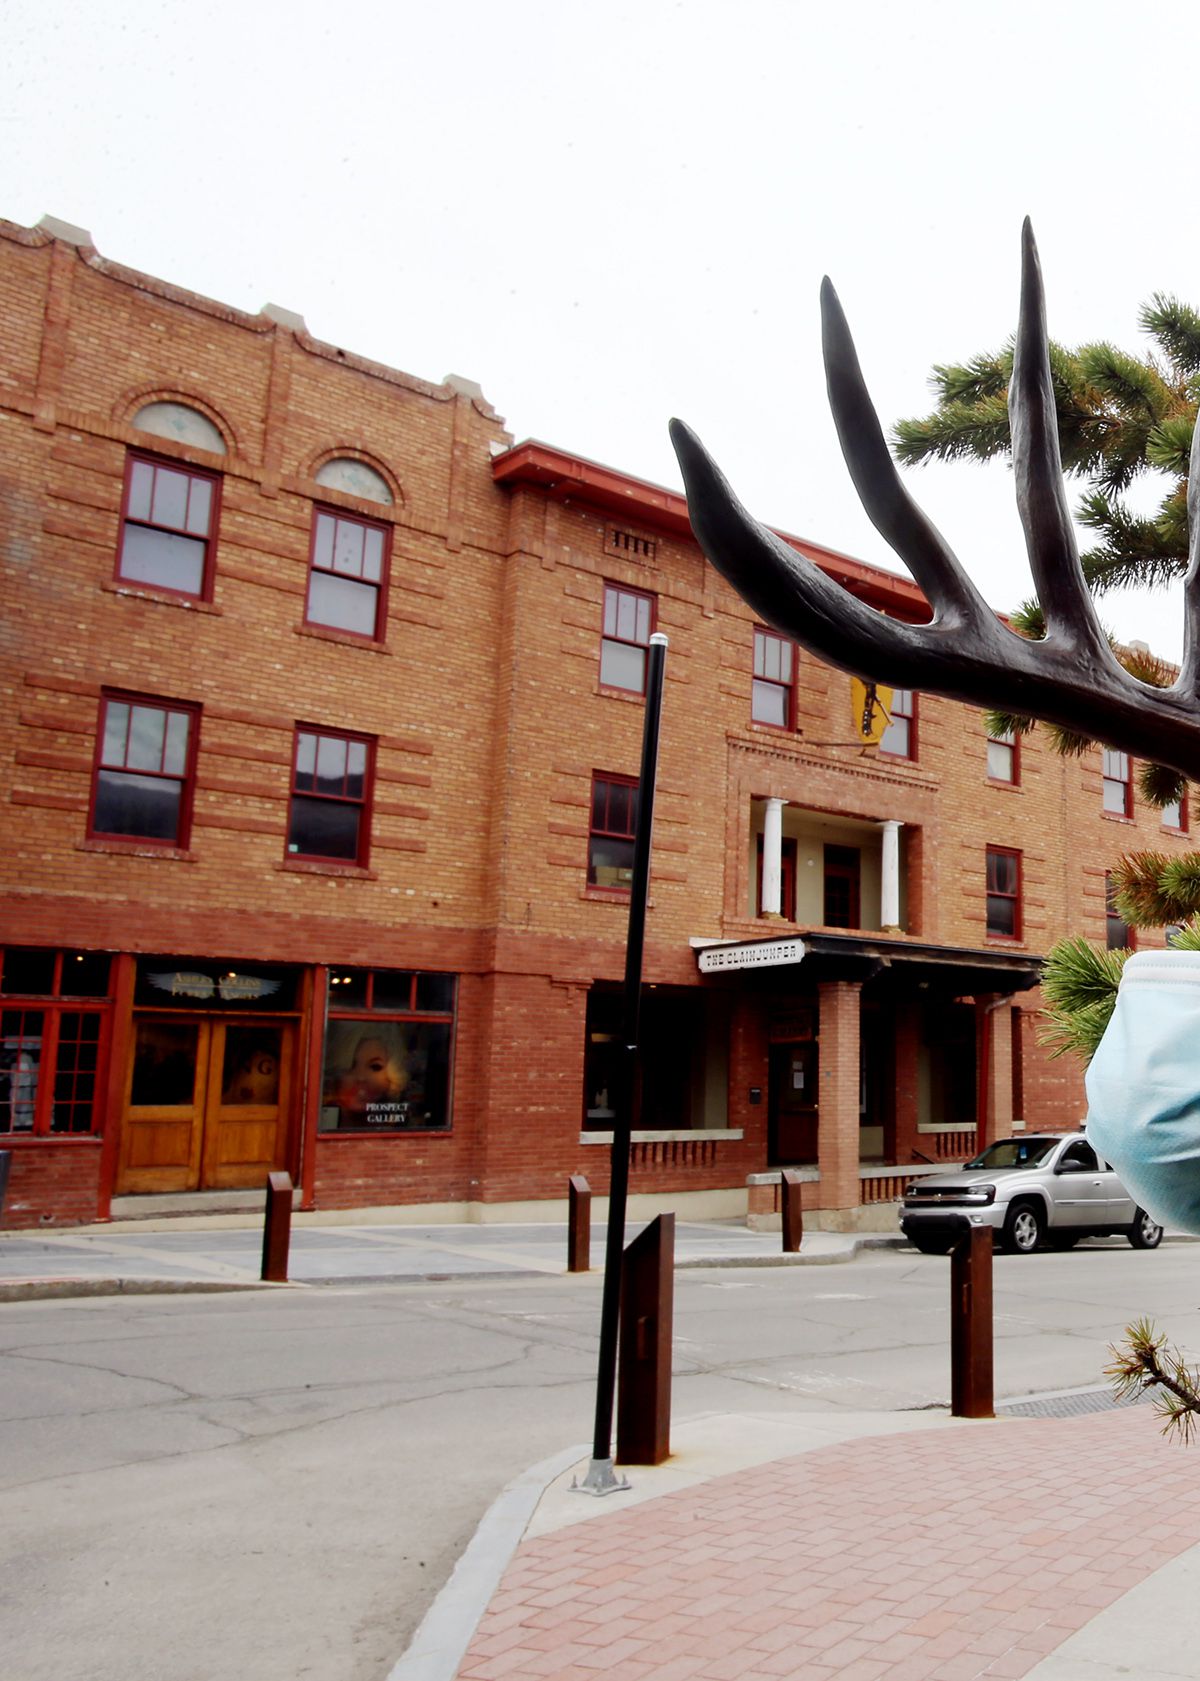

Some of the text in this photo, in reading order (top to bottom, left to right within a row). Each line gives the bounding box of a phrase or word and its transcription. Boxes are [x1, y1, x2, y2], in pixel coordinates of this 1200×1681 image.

[706, 945, 796, 966] THE CLAIMJUMPER
[365, 1103, 409, 1112] PROSPECT
[367, 1114, 405, 1123] GALLERY
